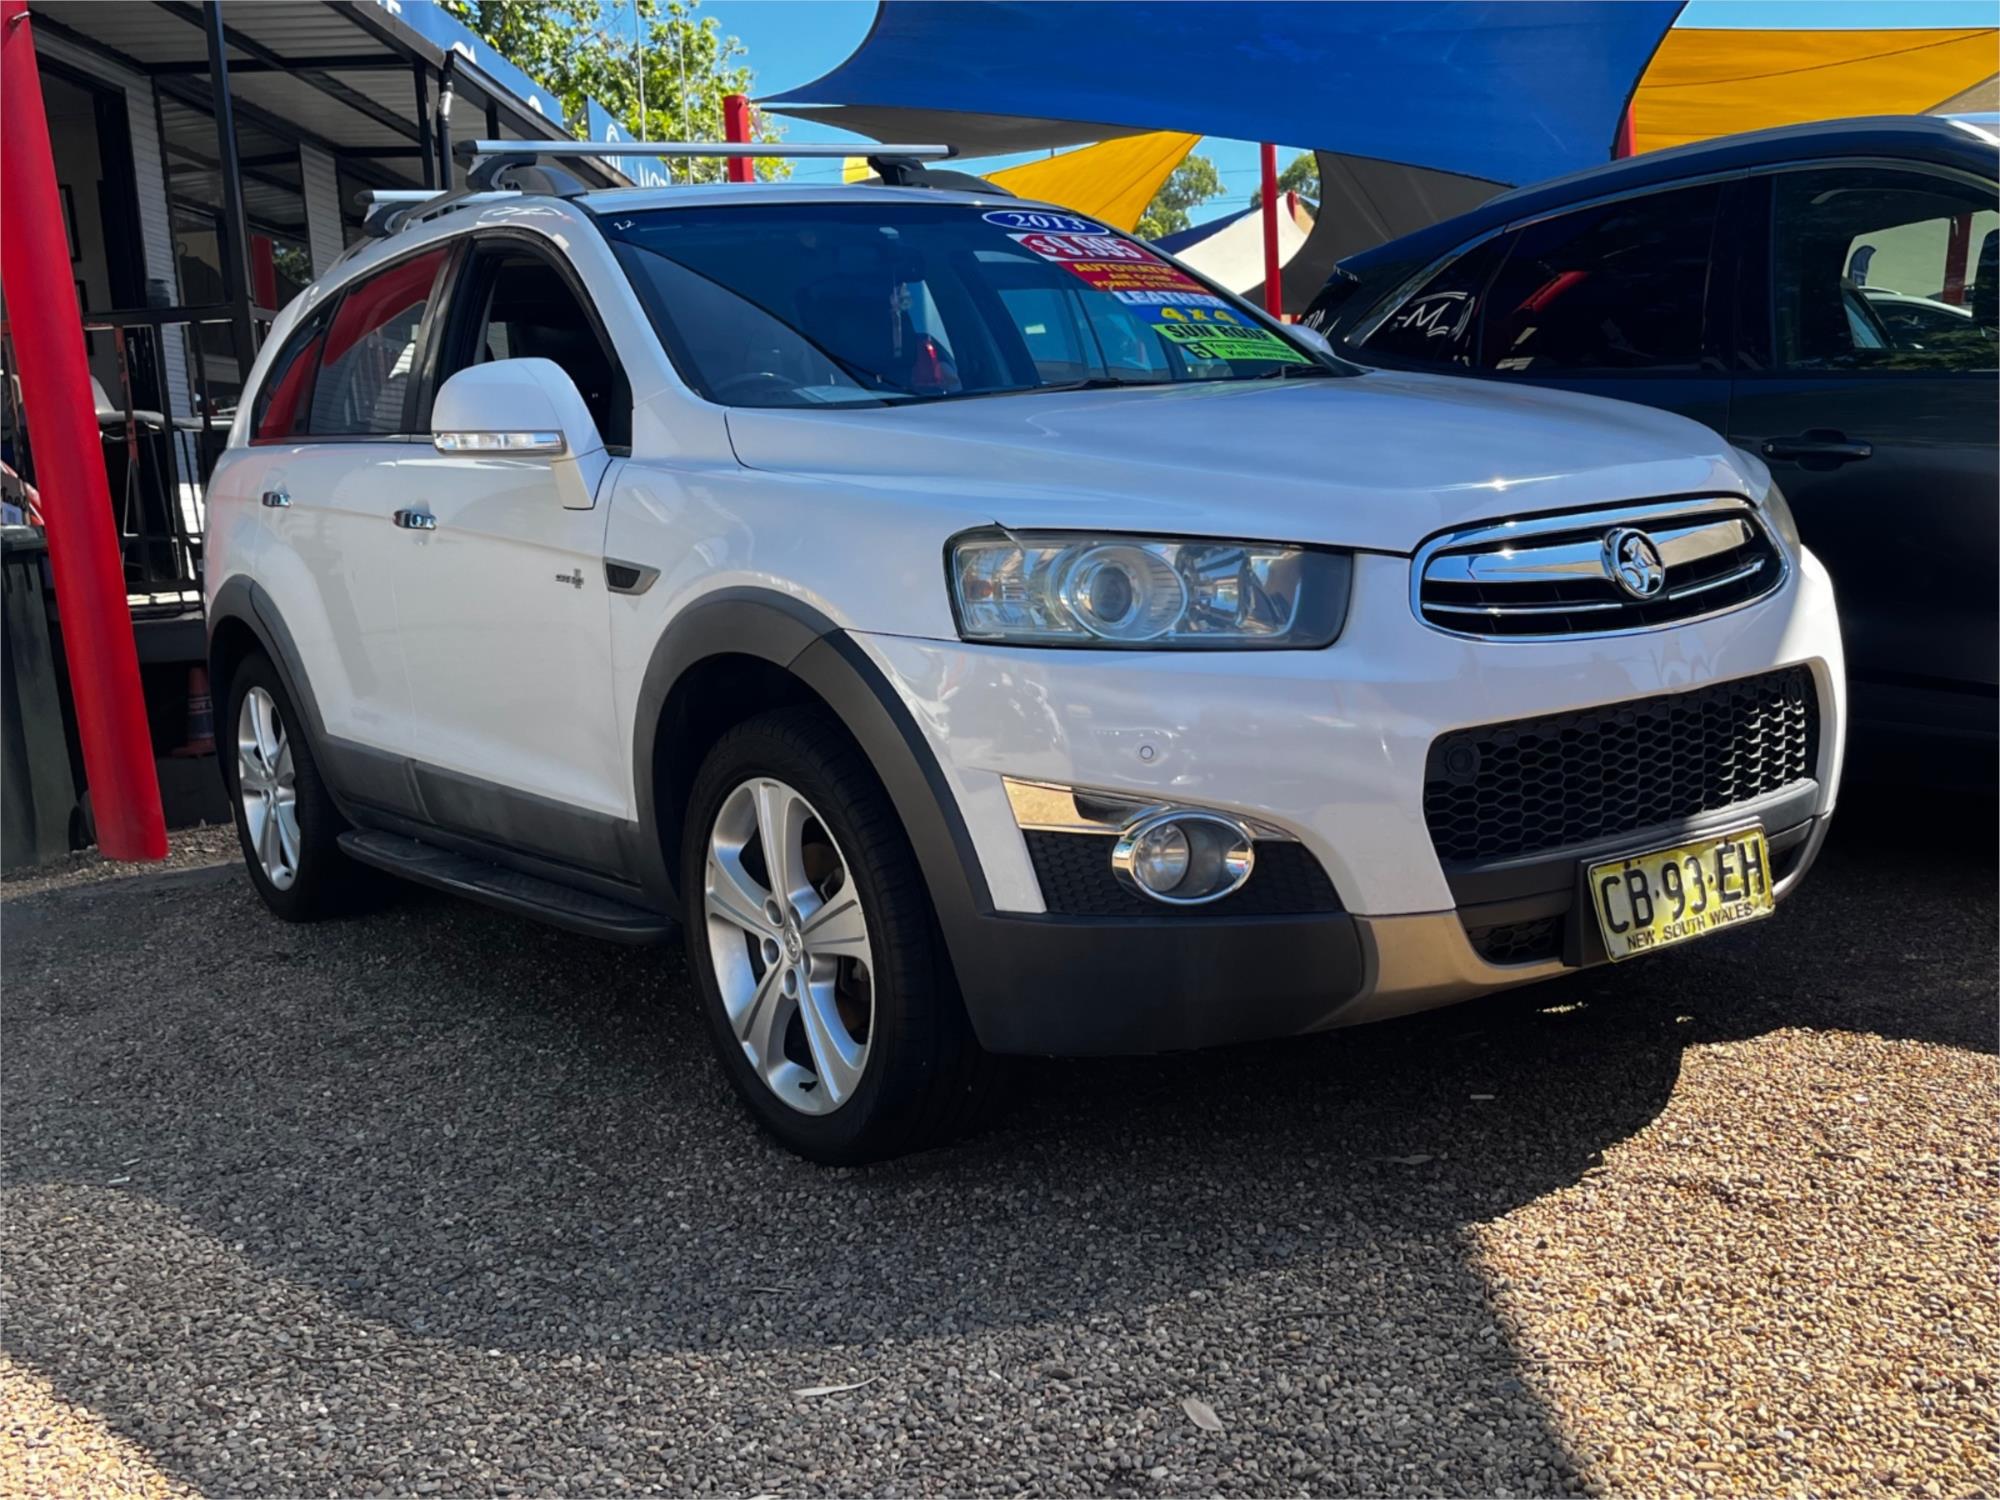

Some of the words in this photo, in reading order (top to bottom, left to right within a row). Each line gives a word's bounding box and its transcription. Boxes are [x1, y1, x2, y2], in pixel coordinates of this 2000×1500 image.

[1007, 213, 1086, 231] 2013
[1114, 290, 1230, 308] LEATHER
[1164, 324, 1219, 338] SUN
[1214, 325, 1271, 340] ROOF
[1190, 343, 1214, 358] 5
[1626, 928, 1656, 951] NEW
[1663, 915, 1705, 941] SOUTH
[1709, 902, 1753, 926] WALES
